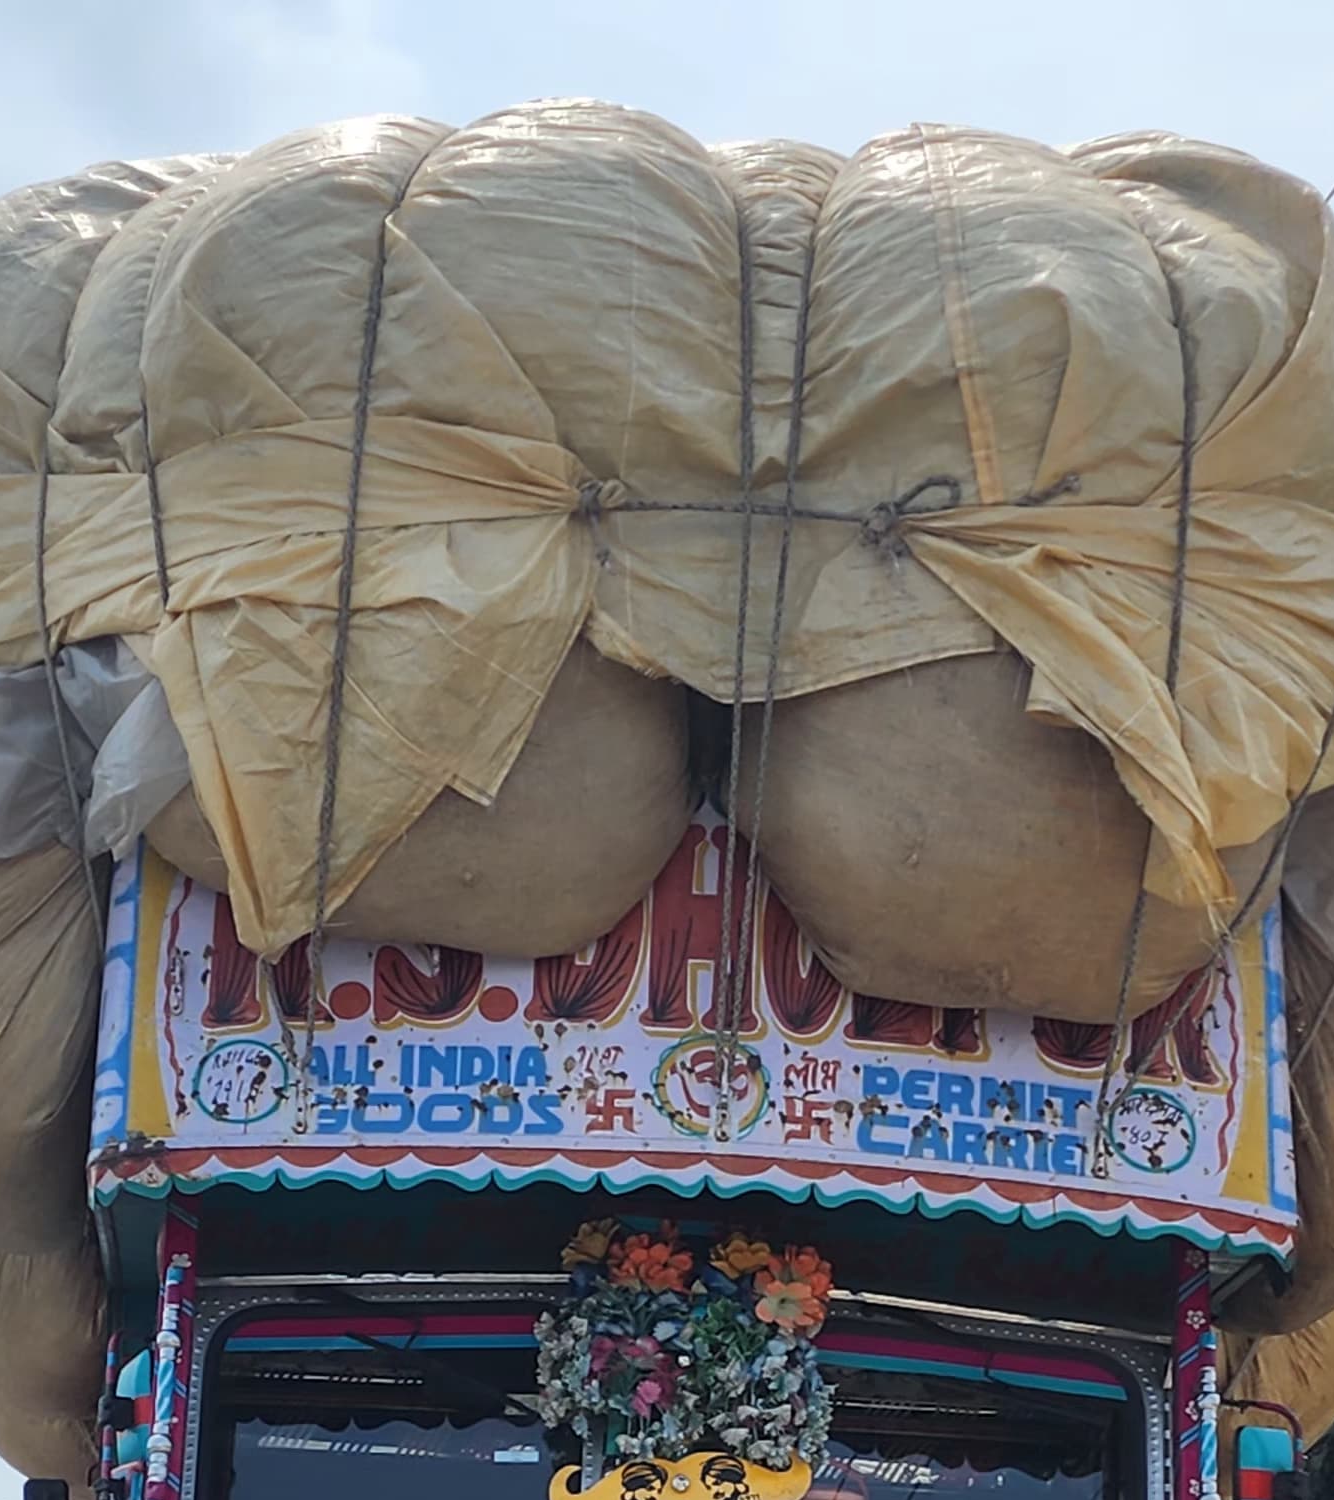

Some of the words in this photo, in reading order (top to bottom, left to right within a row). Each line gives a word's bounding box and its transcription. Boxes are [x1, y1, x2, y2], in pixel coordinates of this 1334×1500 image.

[309, 1045, 376, 1087] ALL
[399, 1045, 548, 1088] INDIA
[314, 1093, 565, 1134] GOODS
[862, 1064, 1093, 1128] PERMIT
